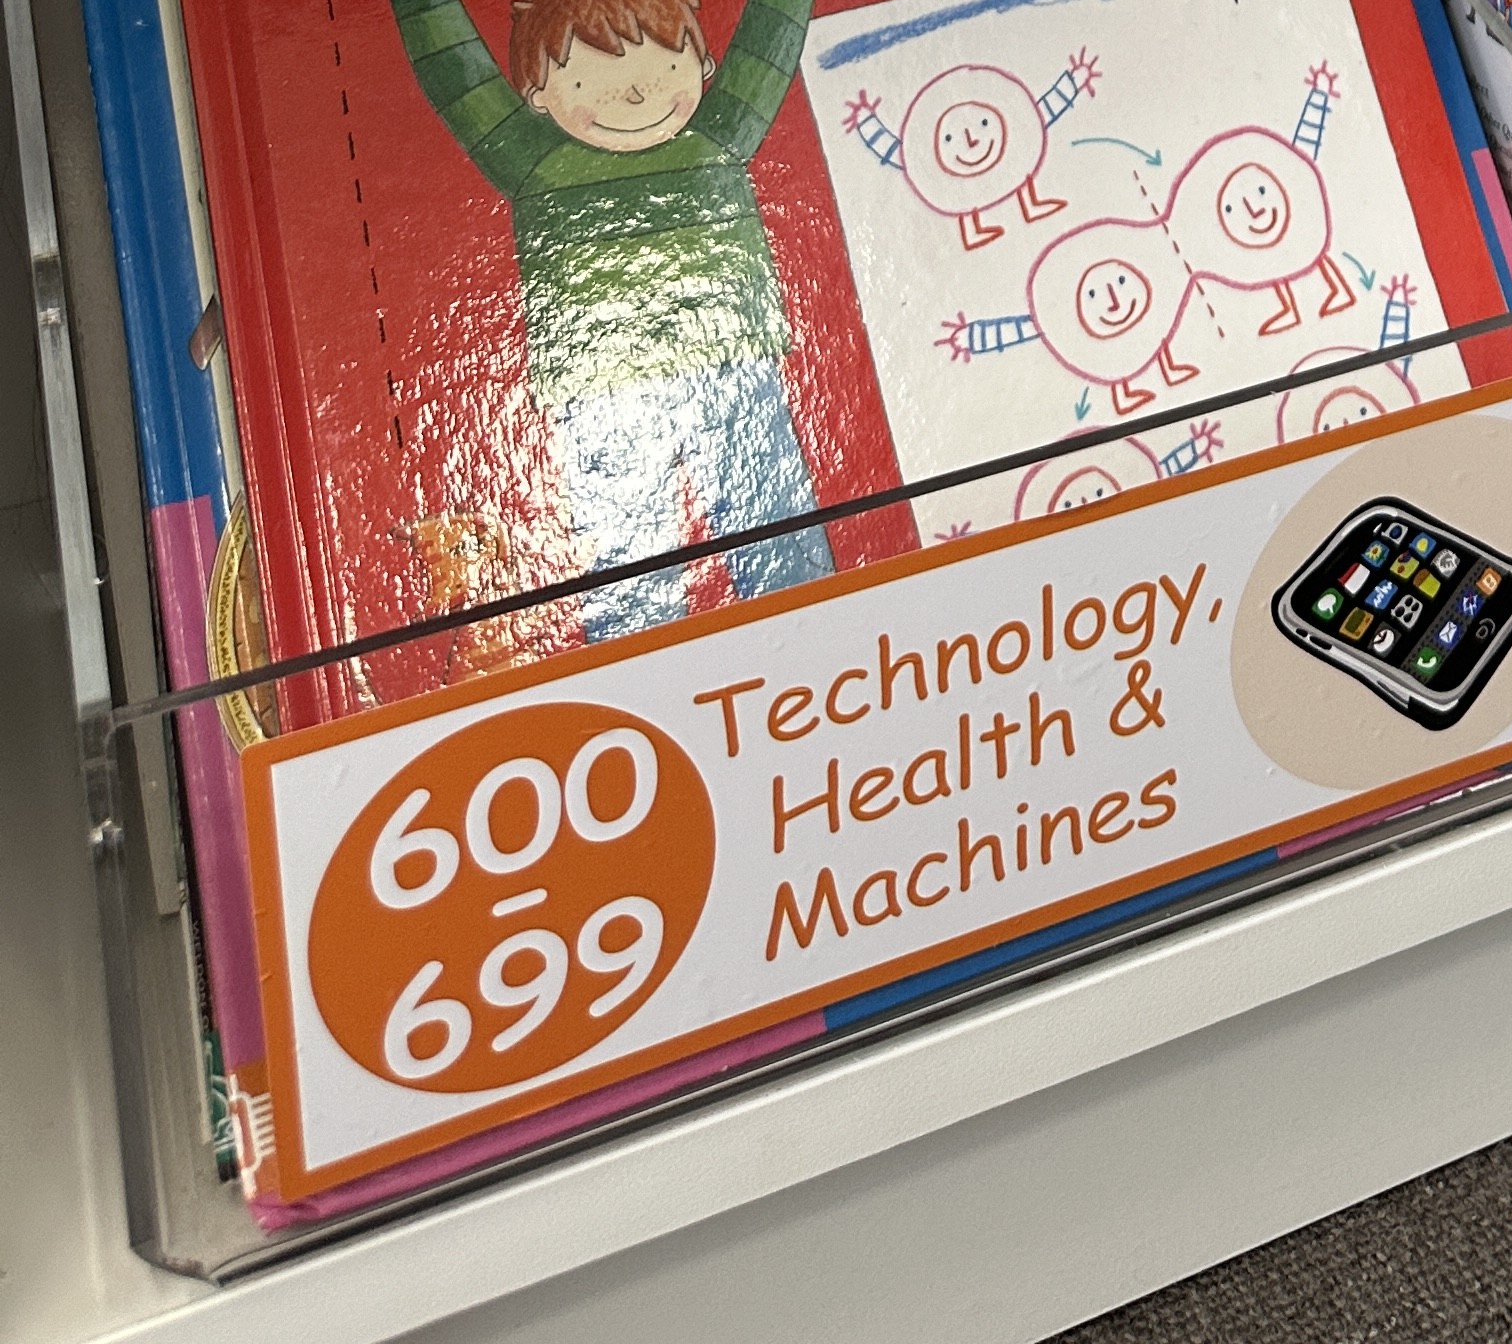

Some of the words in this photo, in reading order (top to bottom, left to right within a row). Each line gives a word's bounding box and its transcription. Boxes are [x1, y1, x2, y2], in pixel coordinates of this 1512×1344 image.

[693, 563, 1224, 759] Technology,
[772, 690, 1076, 854] Health
[1108, 660, 1167, 736] &
[369, 726, 658, 910] 600
[765, 766, 1179, 964] Machines
[382, 893, 665, 1080] 699
